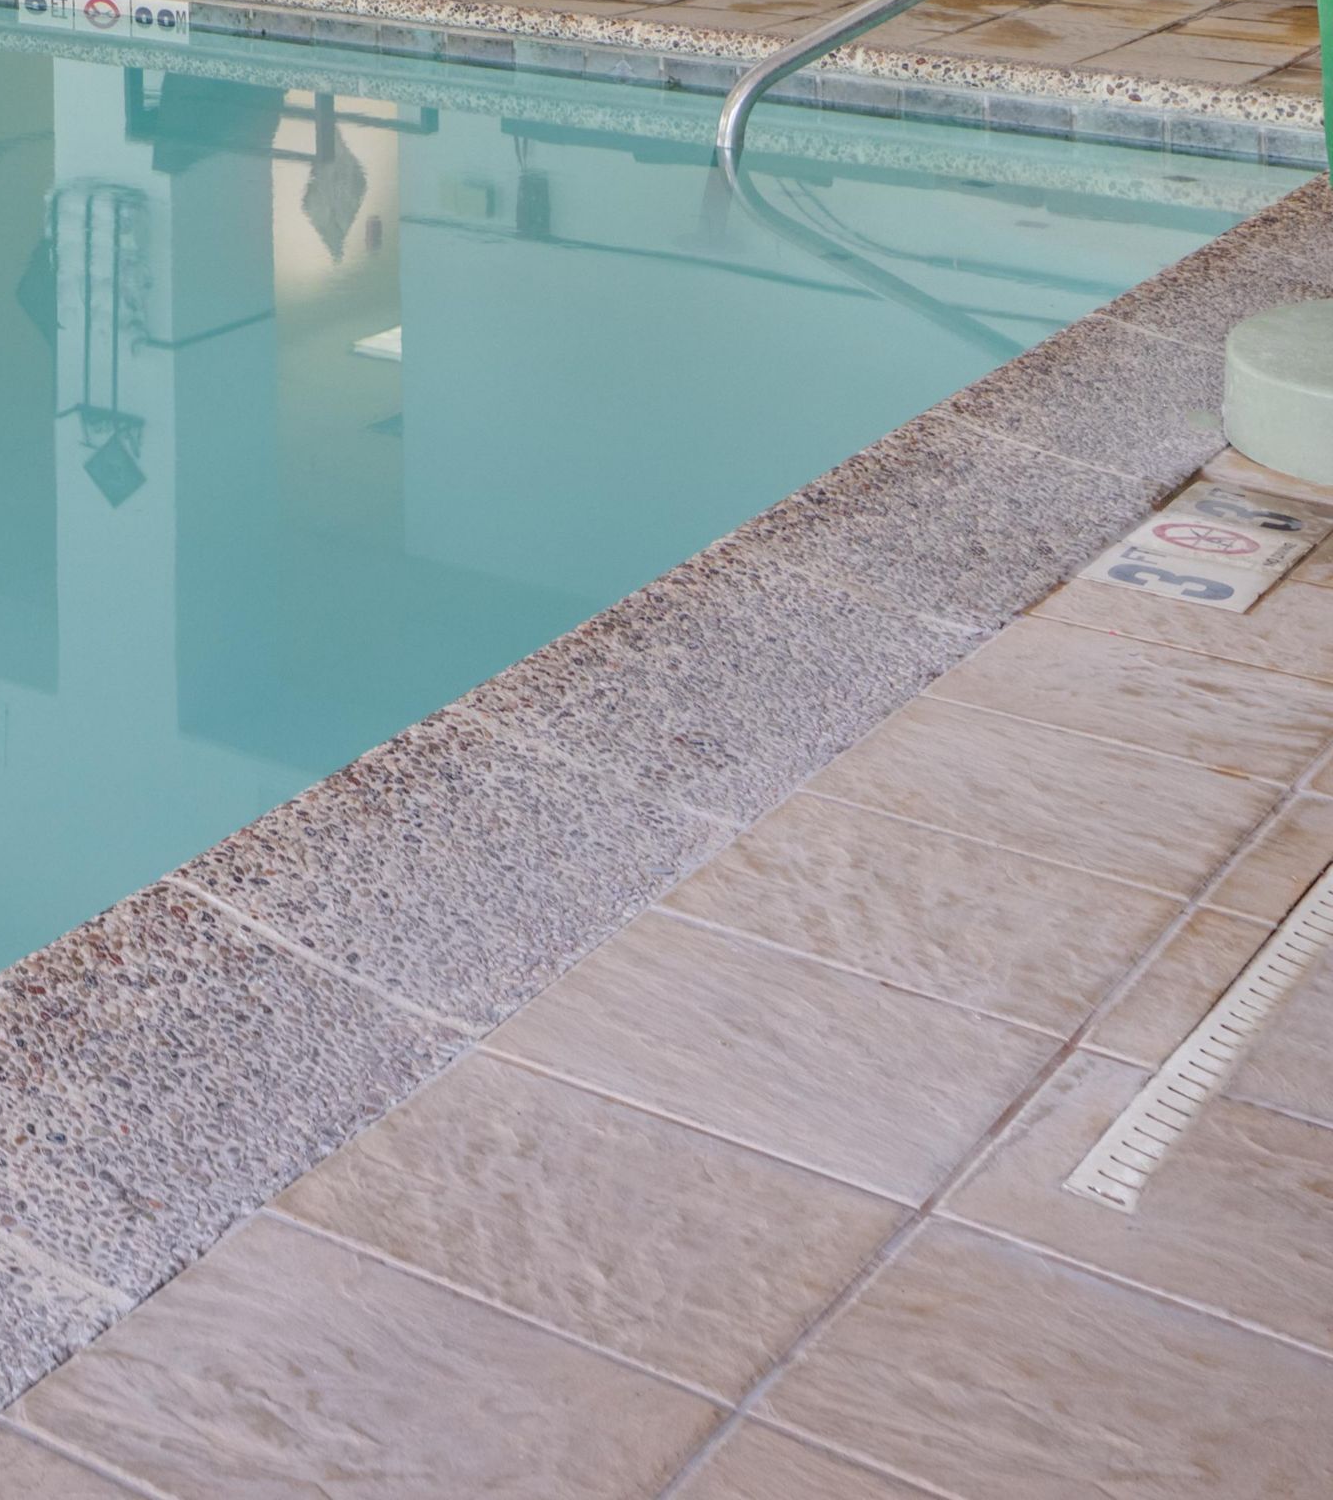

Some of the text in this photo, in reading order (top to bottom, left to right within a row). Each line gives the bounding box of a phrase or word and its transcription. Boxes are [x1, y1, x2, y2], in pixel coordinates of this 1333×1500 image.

[1194, 499, 1303, 532] 3
[1107, 546, 1235, 601] 3 FT
